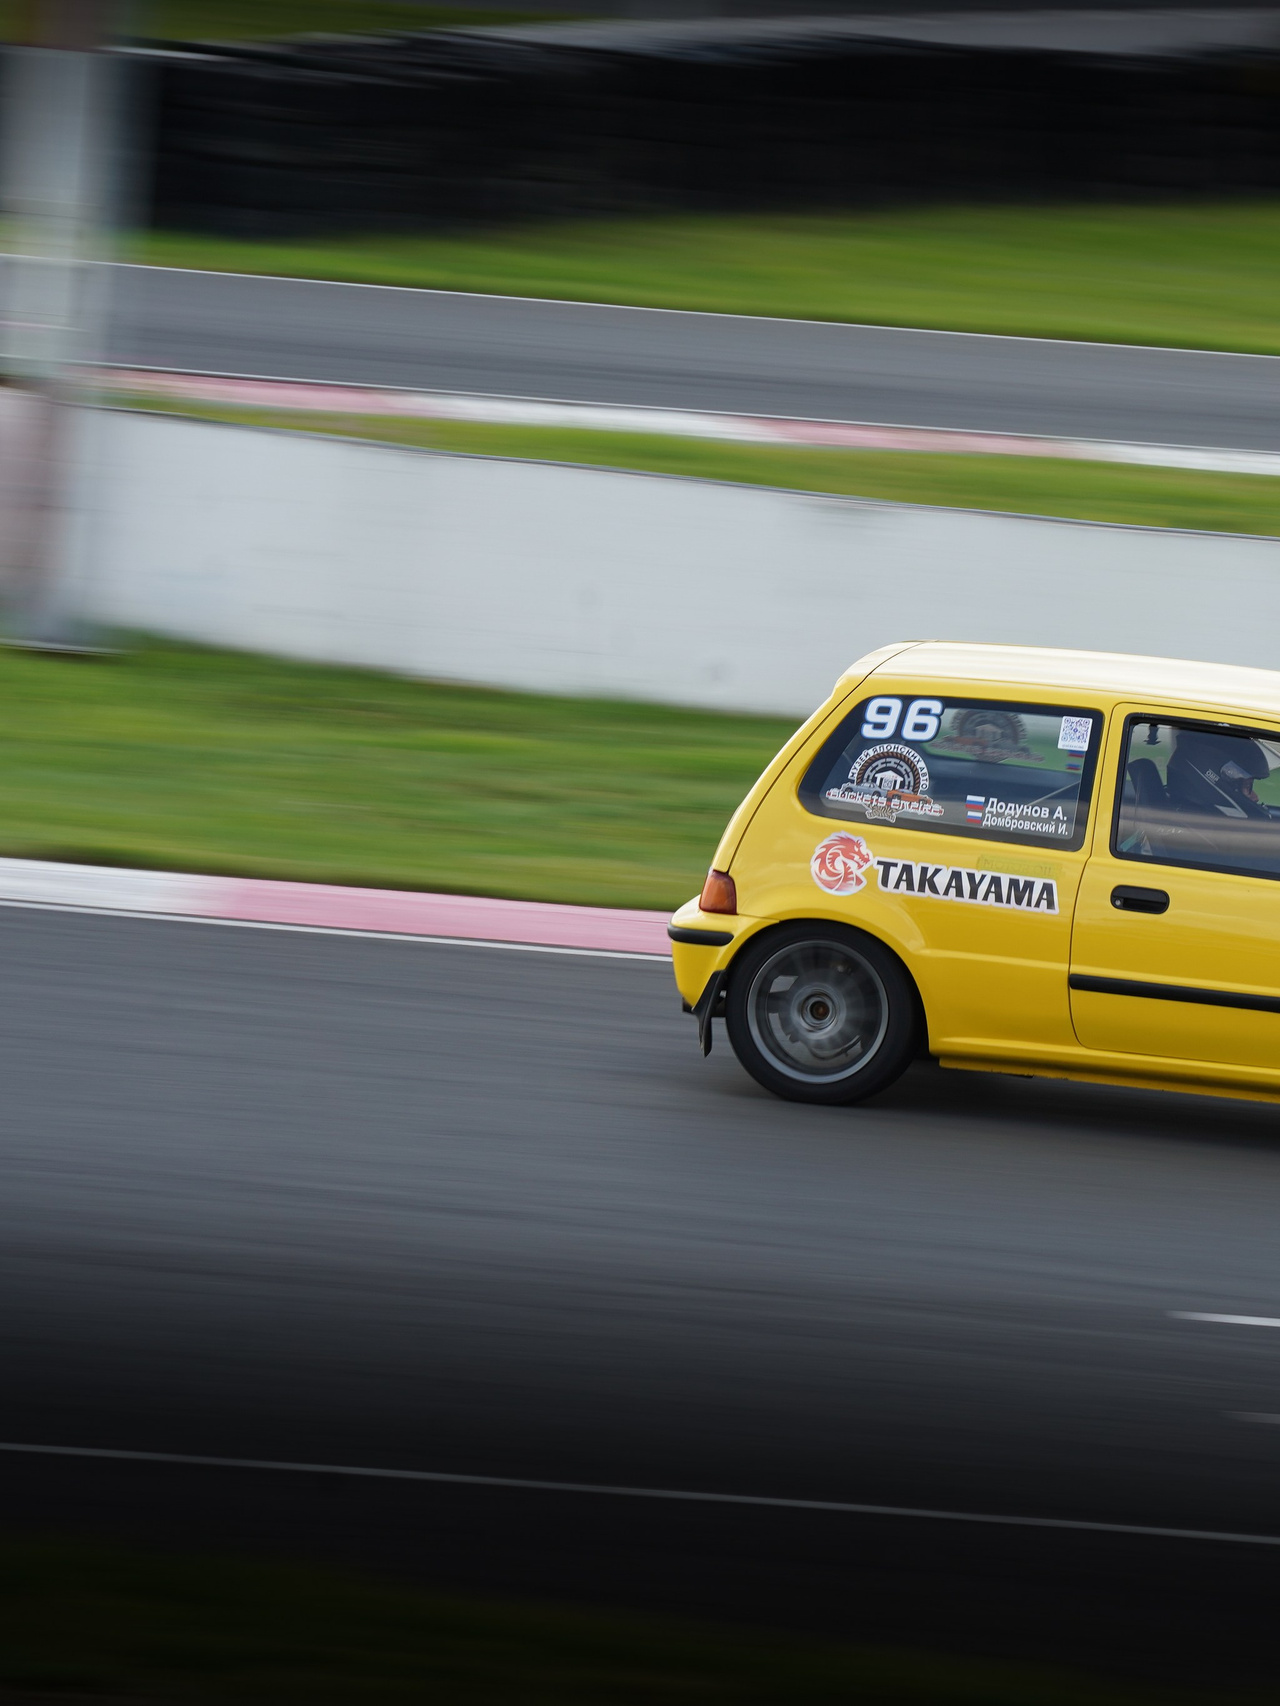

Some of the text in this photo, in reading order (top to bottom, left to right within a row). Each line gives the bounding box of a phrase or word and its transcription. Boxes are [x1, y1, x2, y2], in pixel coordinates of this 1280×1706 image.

[860, 697, 944, 742] 96
[850, 750, 870, 778] МУЗЕЙ
[872, 744, 922, 765] ЯПОНСКИХ
[919, 766, 928, 790] АВТО
[983, 813, 1068, 835] Домбровский И.
[985, 797, 1067, 821] Додунов А.
[877, 859, 1057, 911] TAKAYAMA
